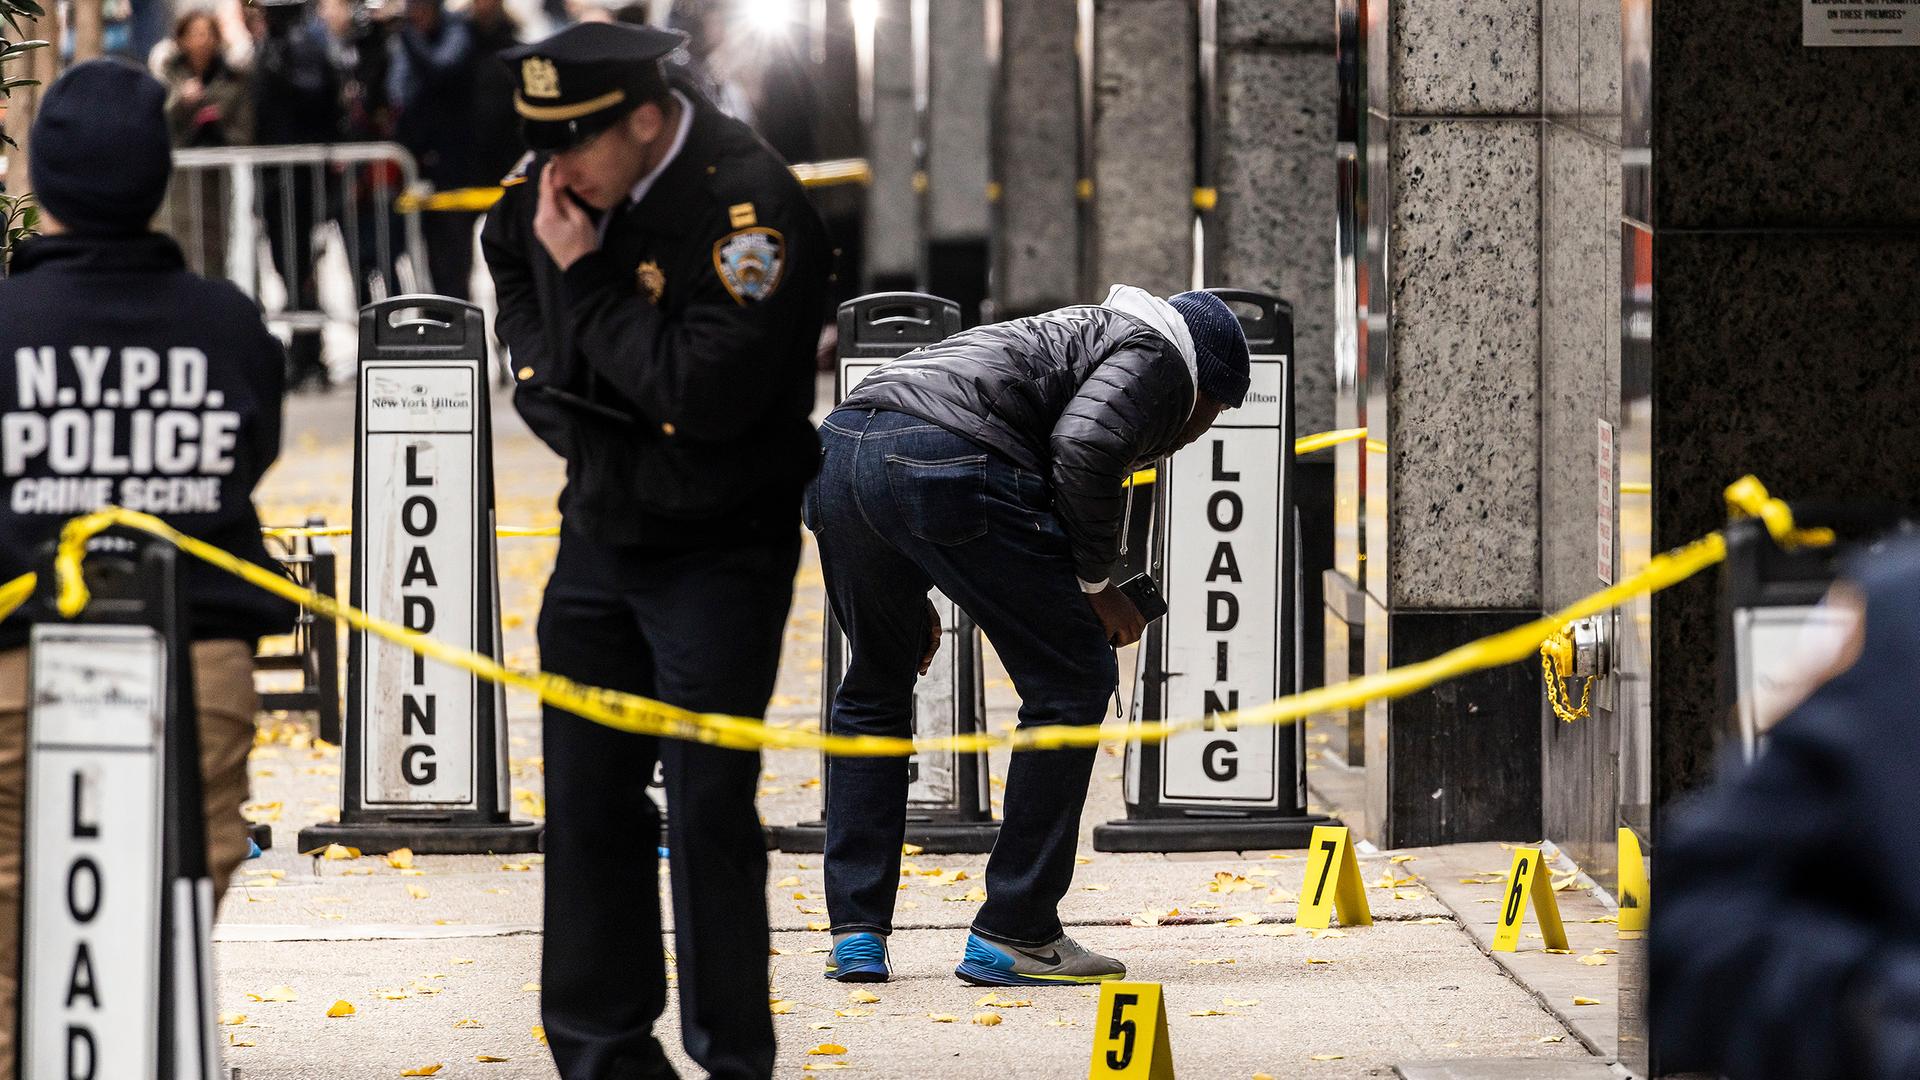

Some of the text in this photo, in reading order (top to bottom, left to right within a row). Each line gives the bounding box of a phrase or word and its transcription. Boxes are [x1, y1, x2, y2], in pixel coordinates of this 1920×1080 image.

[15, 346, 225, 409] N.Y.P.D.
[372, 398, 398, 408] New
[401, 397, 427, 408] York
[1, 408, 241, 477] POLICE
[11, 476, 222, 515] CRIME SCENE
[401, 445, 438, 787] LOADING
[1202, 440, 1243, 782] LOADING
[1313, 841, 1337, 906] 7
[1506, 858, 1528, 926] 6
[1106, 993, 1138, 1070] 5
